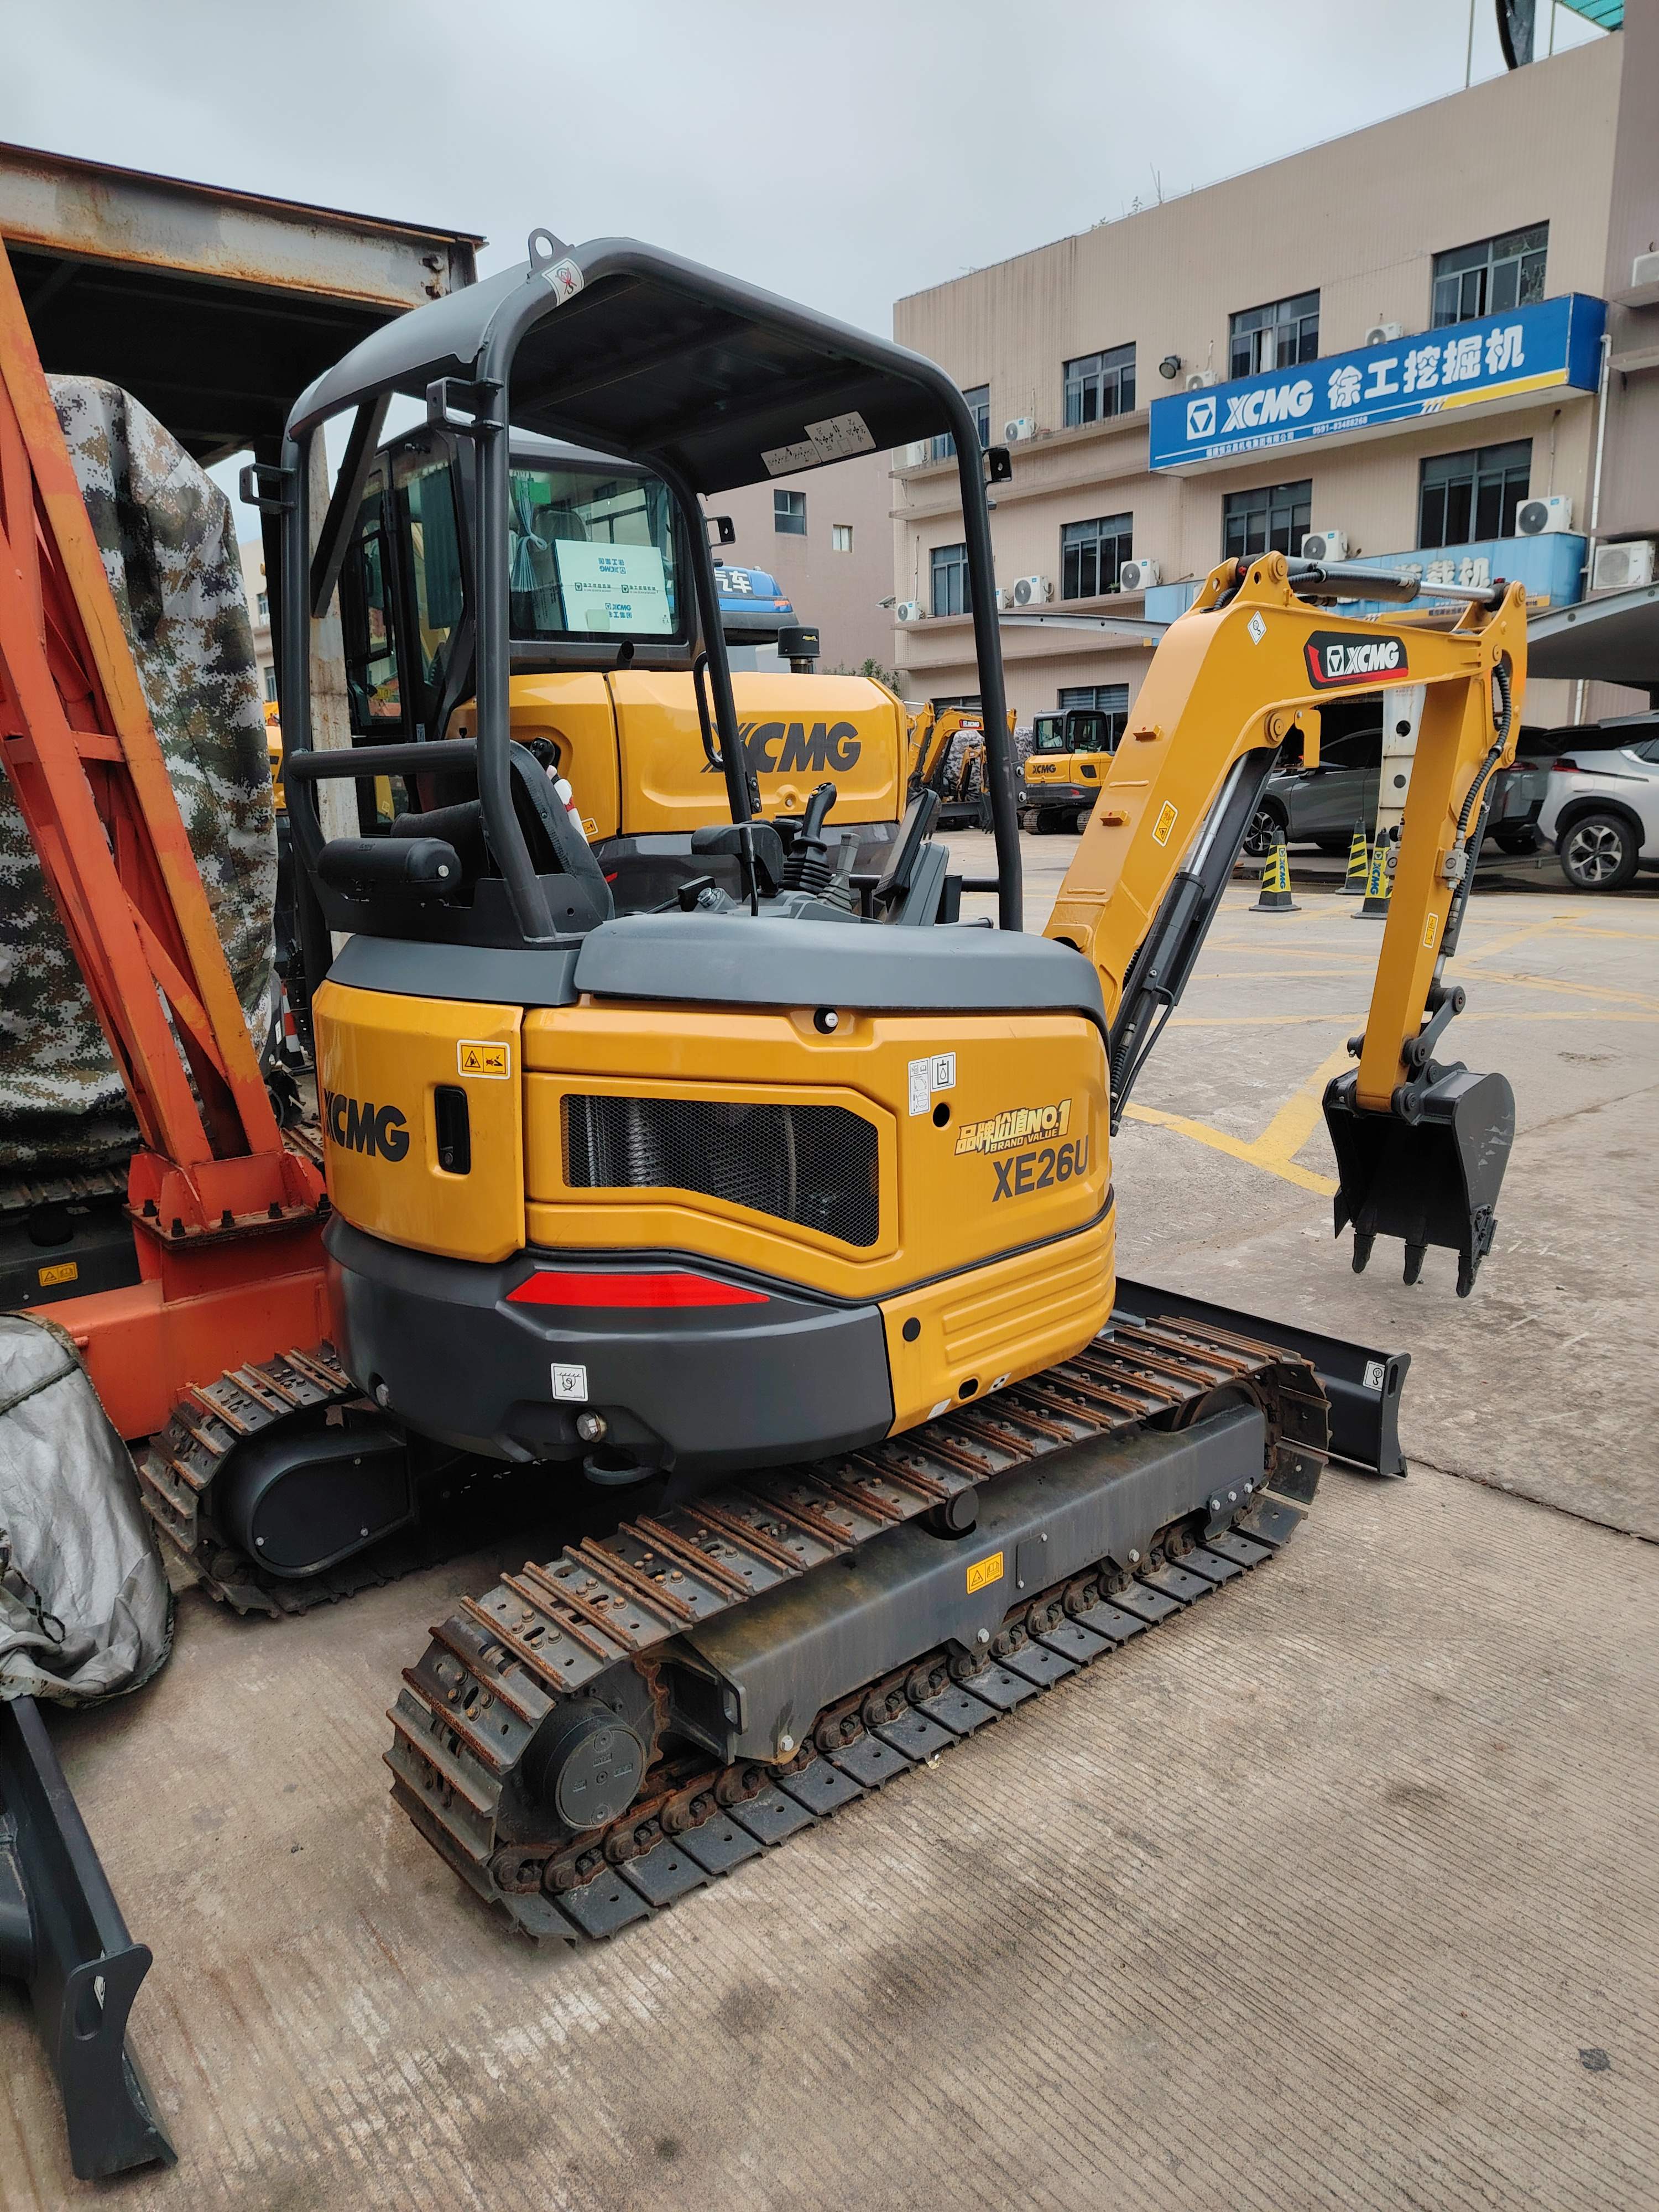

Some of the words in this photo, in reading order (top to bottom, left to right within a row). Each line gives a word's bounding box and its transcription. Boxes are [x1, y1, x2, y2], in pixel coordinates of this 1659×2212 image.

[1221, 379, 1314, 433] XCMG
[1328, 324, 1525, 410] 徐工挖掘机
[1344, 641, 1399, 675] XCMG
[1032, 764, 1056, 774] XCMG
[1370, 862, 1381, 895] XCMG
[324, 1088, 410, 1162] XCMG
[990, 1138, 1024, 1152] BRAND
[1027, 1128, 1058, 1144] VALUE
[992, 1135, 1089, 1202] XE26U
